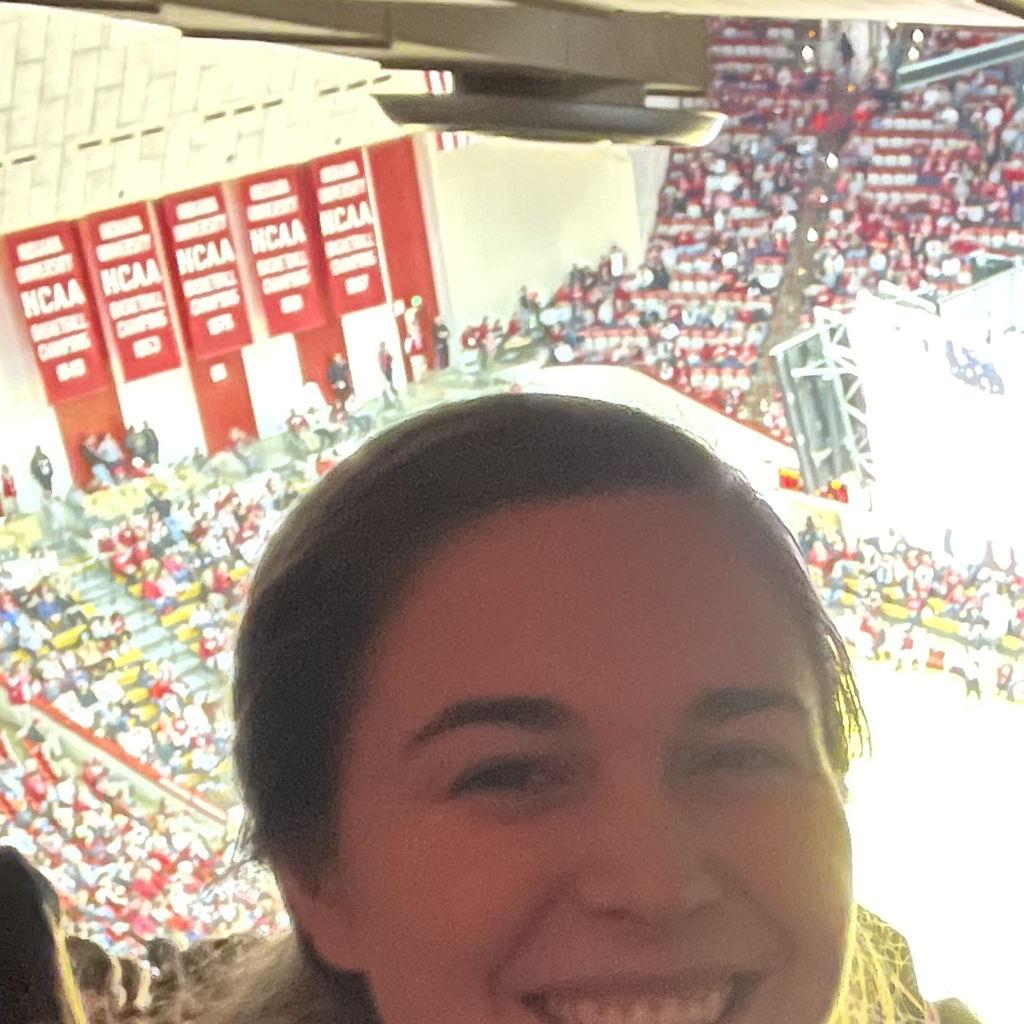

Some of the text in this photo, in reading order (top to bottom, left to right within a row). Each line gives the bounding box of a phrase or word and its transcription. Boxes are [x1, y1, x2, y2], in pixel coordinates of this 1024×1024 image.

[250, 218, 307, 255] NCAA
[319, 201, 373, 236] NCAA
[175, 237, 236, 275] NCAA
[100, 258, 162, 296] NCAA
[20, 278, 86, 319] NCAA
